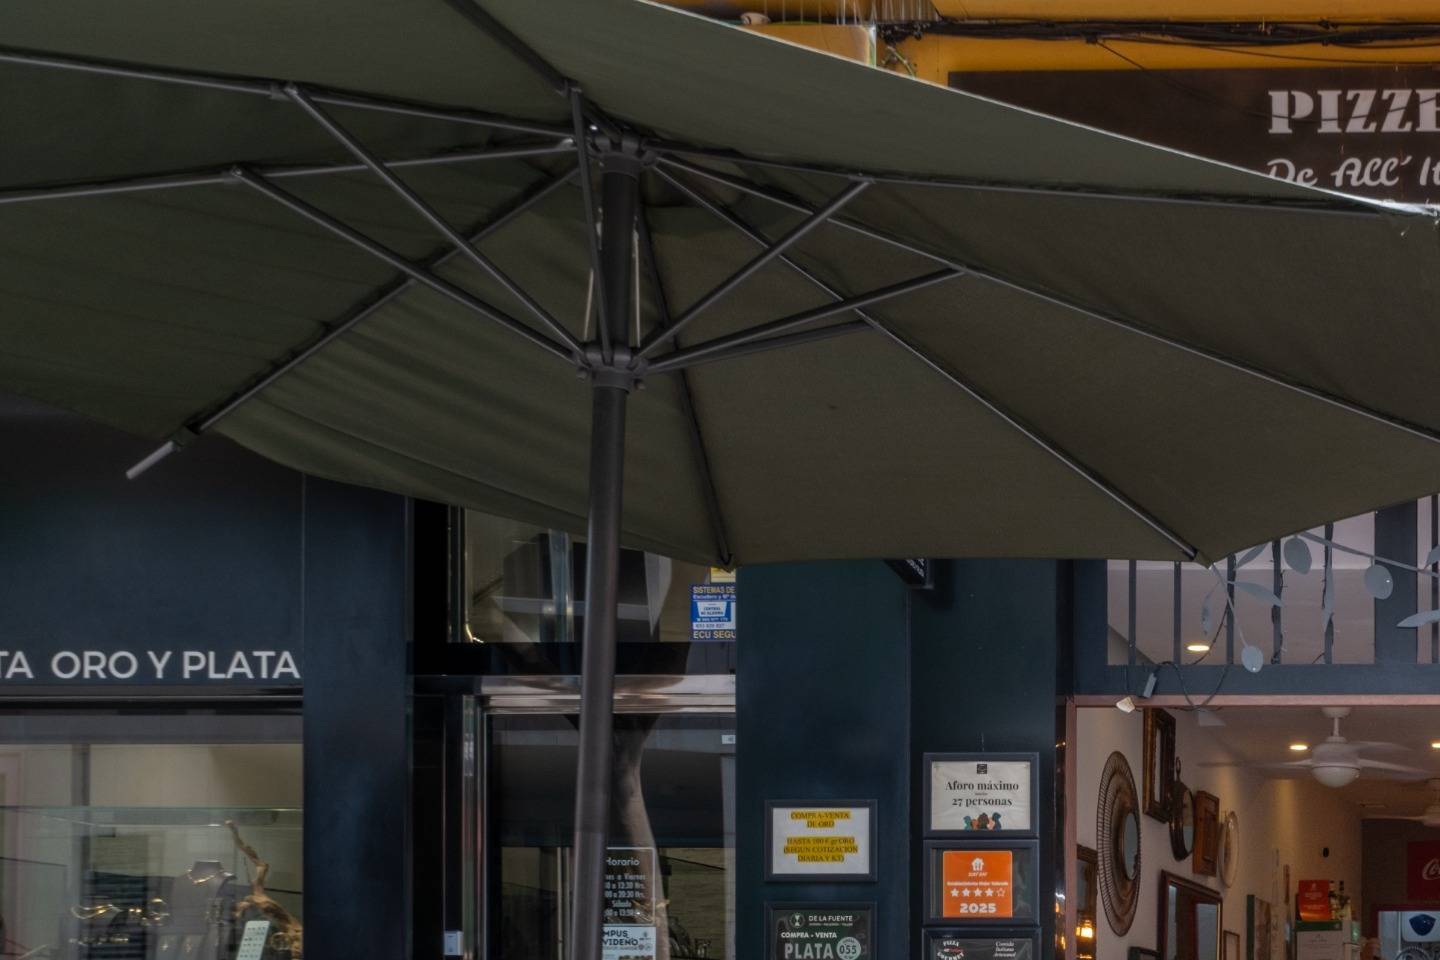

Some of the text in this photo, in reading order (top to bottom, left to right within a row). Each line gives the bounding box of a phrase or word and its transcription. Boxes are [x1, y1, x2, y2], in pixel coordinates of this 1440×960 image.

[1266, 158, 1318, 186] De
[692, 586, 725, 594] SISTEMAS
[693, 630, 736, 639] ECU SEGU
[51, 650, 139, 679] ORO
[147, 651, 172, 679] Y
[183, 651, 301, 679] PLATA
[945, 781, 1019, 791] Aforo máximo
[952, 798, 1012, 807] 27 personas
[960, 903, 997, 913] 2025
[603, 930, 628, 938] MPUS
[603, 936, 638, 946] VIDEÑO
[784, 943, 834, 959] PLATA
